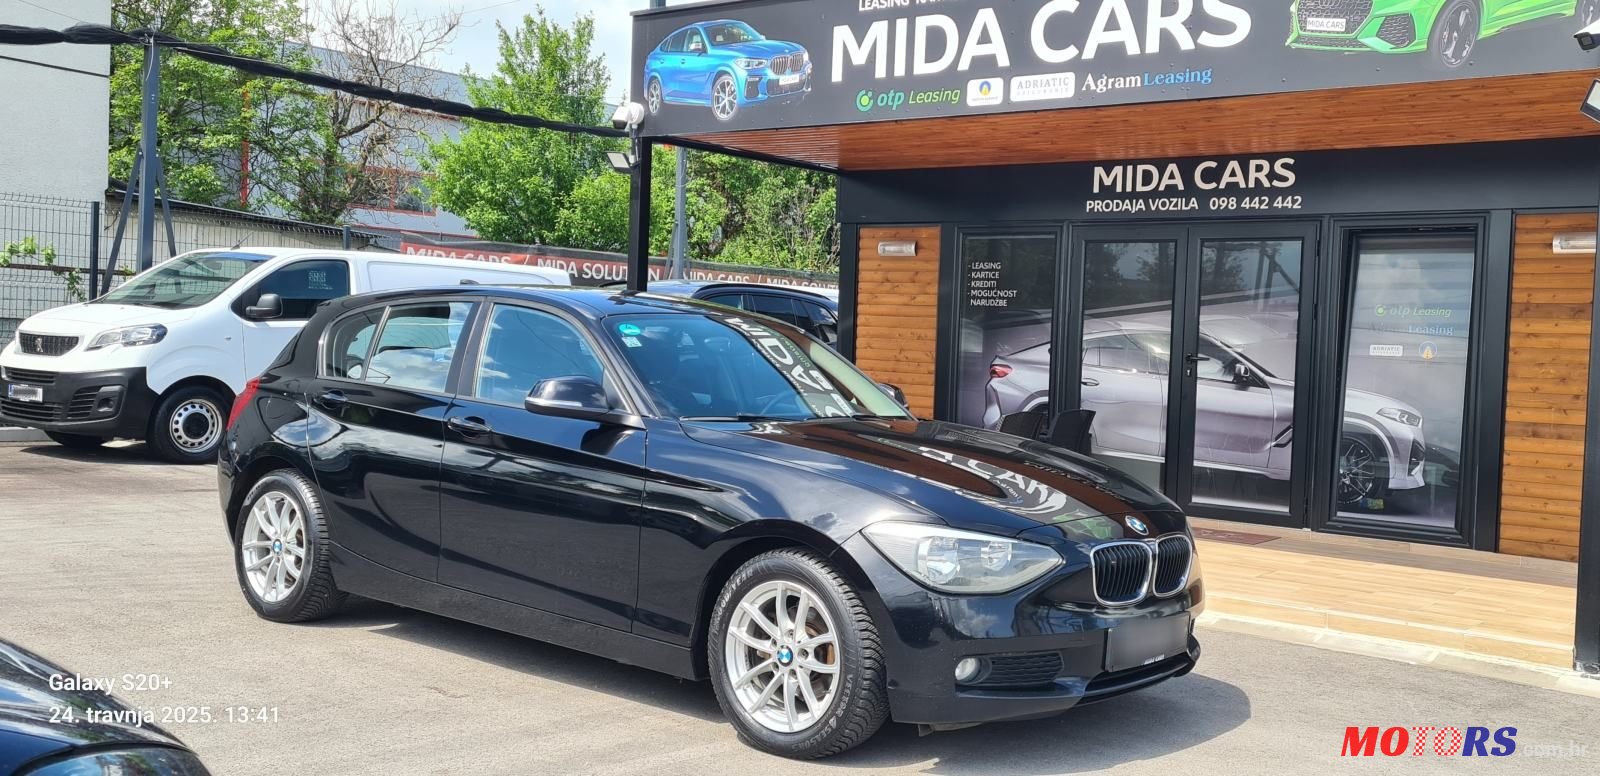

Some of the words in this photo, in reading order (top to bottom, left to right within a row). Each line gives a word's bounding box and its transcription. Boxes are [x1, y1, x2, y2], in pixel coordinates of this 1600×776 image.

[831, 7, 1010, 83] MIDA
[1030, 0, 1252, 64] CARS
[1016, 77, 1070, 90] ADRIATIC
[877, 90, 904, 110] otp
[909, 88, 961, 104] Leasing
[1093, 163, 1185, 193] MIDA
[1194, 157, 1296, 190] CARS
[1086, 199, 1146, 213] PRODAJA
[1149, 197, 1199, 211] VOZILA
[1209, 197, 1237, 210] 098
[1241, 196, 1269, 209] 442
[1273, 195, 1302, 209] 442
[971, 262, 1001, 270] LEASING
[971, 271, 1000, 279] KARTICE
[971, 280, 997, 288] KREDITI
[970, 288, 1018, 298] MOGUĆNOST
[970, 298, 1008, 307] NARUDŽBE
[1413, 306, 1452, 318] Leasing
[1408, 324, 1453, 336] Leasing
